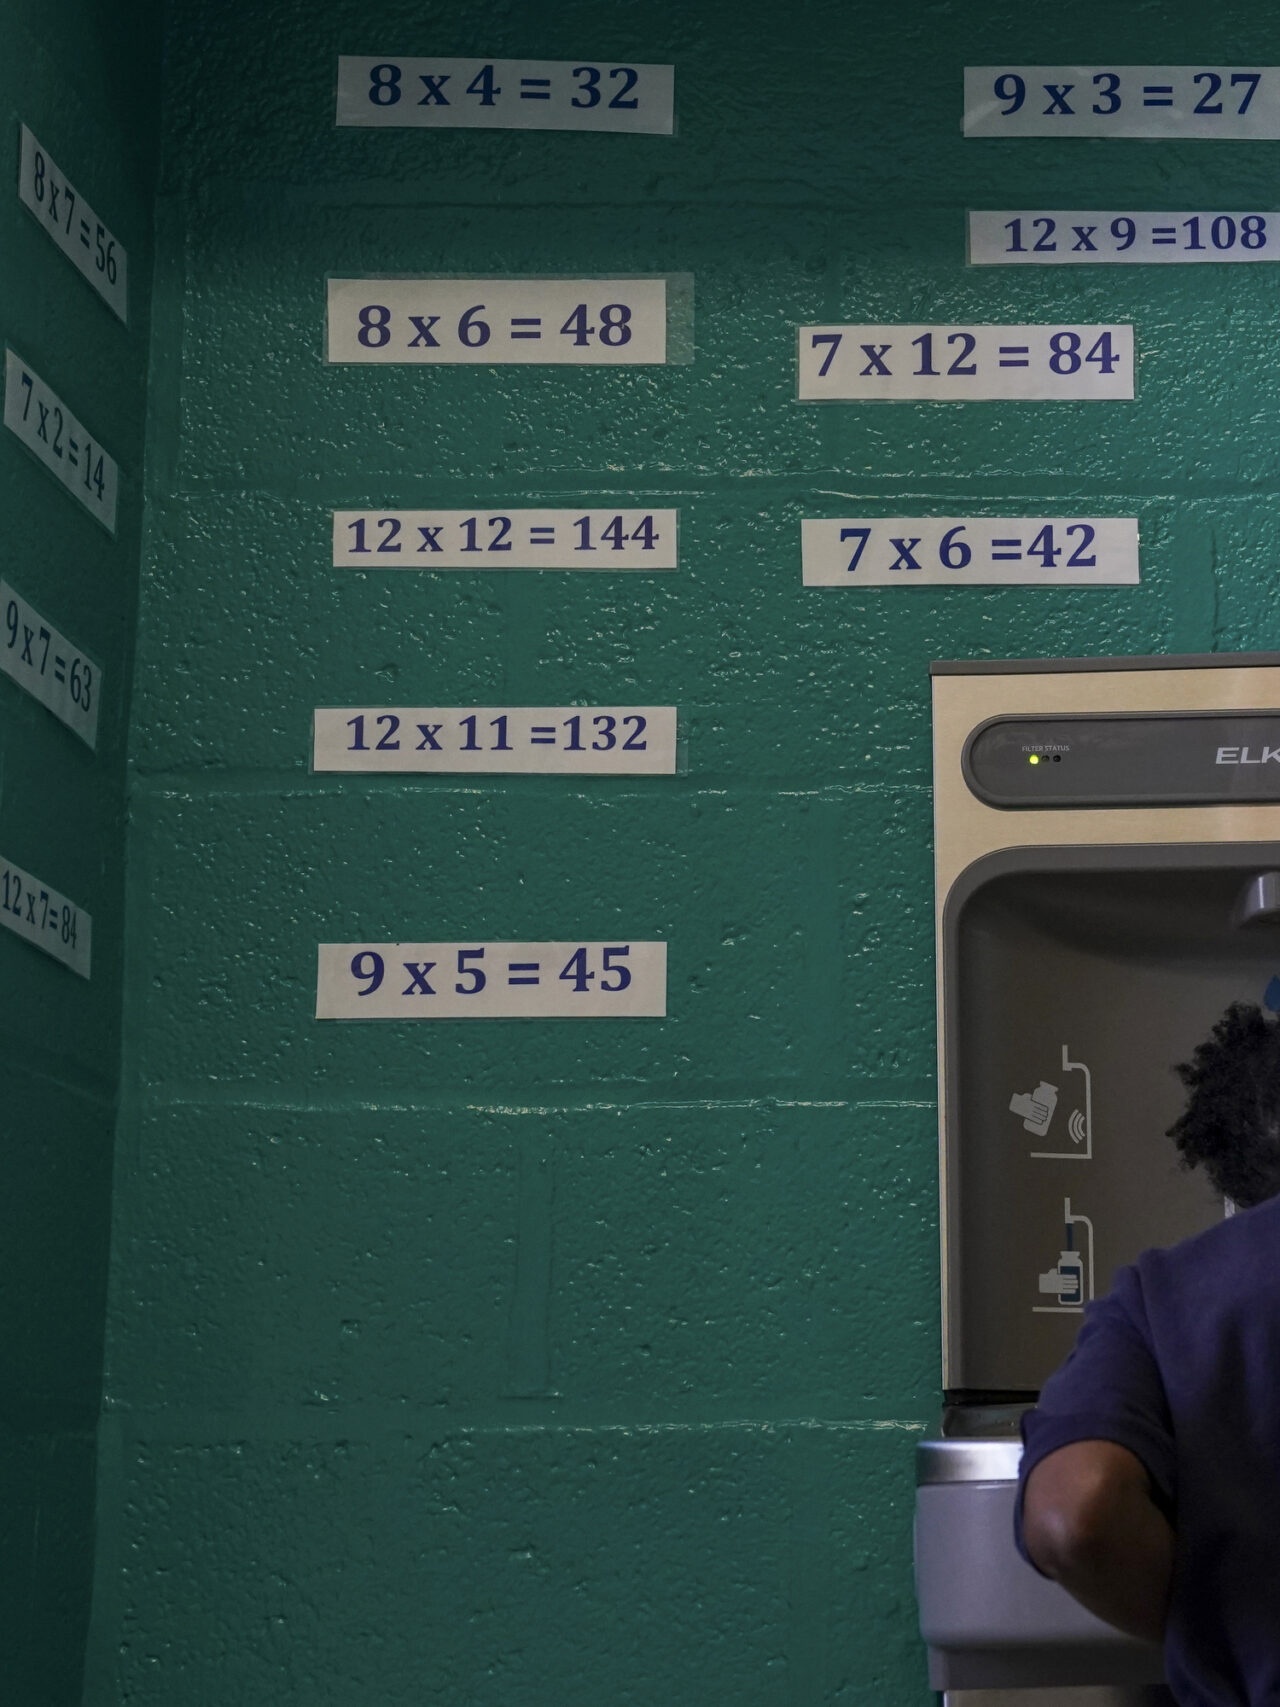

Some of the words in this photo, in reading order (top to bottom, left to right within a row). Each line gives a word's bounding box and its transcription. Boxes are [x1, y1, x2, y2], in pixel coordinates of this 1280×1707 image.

[369, 64, 401, 106] 8
[418, 75, 450, 105] x
[466, 65, 501, 106] 4
[520, 79, 551, 99] =
[572, 67, 638, 109] 32
[994, 74, 1025, 115] 9
[1043, 85, 1075, 114] x
[1093, 73, 1121, 114] 3
[1144, 87, 1173, 106] =
[1194, 73, 1261, 114] 27
[34, 152, 46, 202] 8
[48, 179, 60, 223] x
[65, 186, 76, 235] 7
[80, 218, 91, 249] =
[95, 223, 117, 285] 56
[1005, 218, 1056, 251] 12
[1072, 227, 1098, 251] x
[1111, 218, 1136, 250] 9
[358, 305, 390, 347] 8
[408, 317, 440, 347] x
[458, 305, 490, 347] 6
[511, 319, 541, 338] =
[560, 304, 631, 346] 48
[812, 334, 842, 376] 7
[860, 345, 892, 375] x
[912, 333, 976, 375] 12
[999, 347, 1028, 367] =
[1049, 332, 1119, 374] 84
[22, 371, 33, 421] 7
[37, 401, 49, 444] x
[52, 407, 63, 458] 2
[68, 438, 78, 466] =
[84, 443, 105, 501] 14
[348, 518, 401, 552] 12
[417, 527, 443, 552] x
[460, 517, 512, 551] 12
[530, 528, 554, 544] =
[574, 516, 659, 550] 144
[840, 528, 871, 571] 7
[889, 538, 921, 570] x
[939, 526, 971, 569] 6
[7, 600, 18, 648] 9
[21, 625, 34, 666] x
[40, 626, 51, 675] 7
[55, 655, 66, 684] =
[70, 658, 92, 712] 63
[347, 715, 400, 750] 12
[416, 725, 443, 750] x
[459, 715, 513, 750] 11
[3, 870, 22, 917] 12
[26, 892, 36, 925] x
[62, 905, 77, 950] 84
[351, 951, 384, 996] 9
[402, 963, 436, 995] x
[456, 948, 486, 994] 5
[509, 963, 539, 985] =
[559, 945, 631, 992] 45
